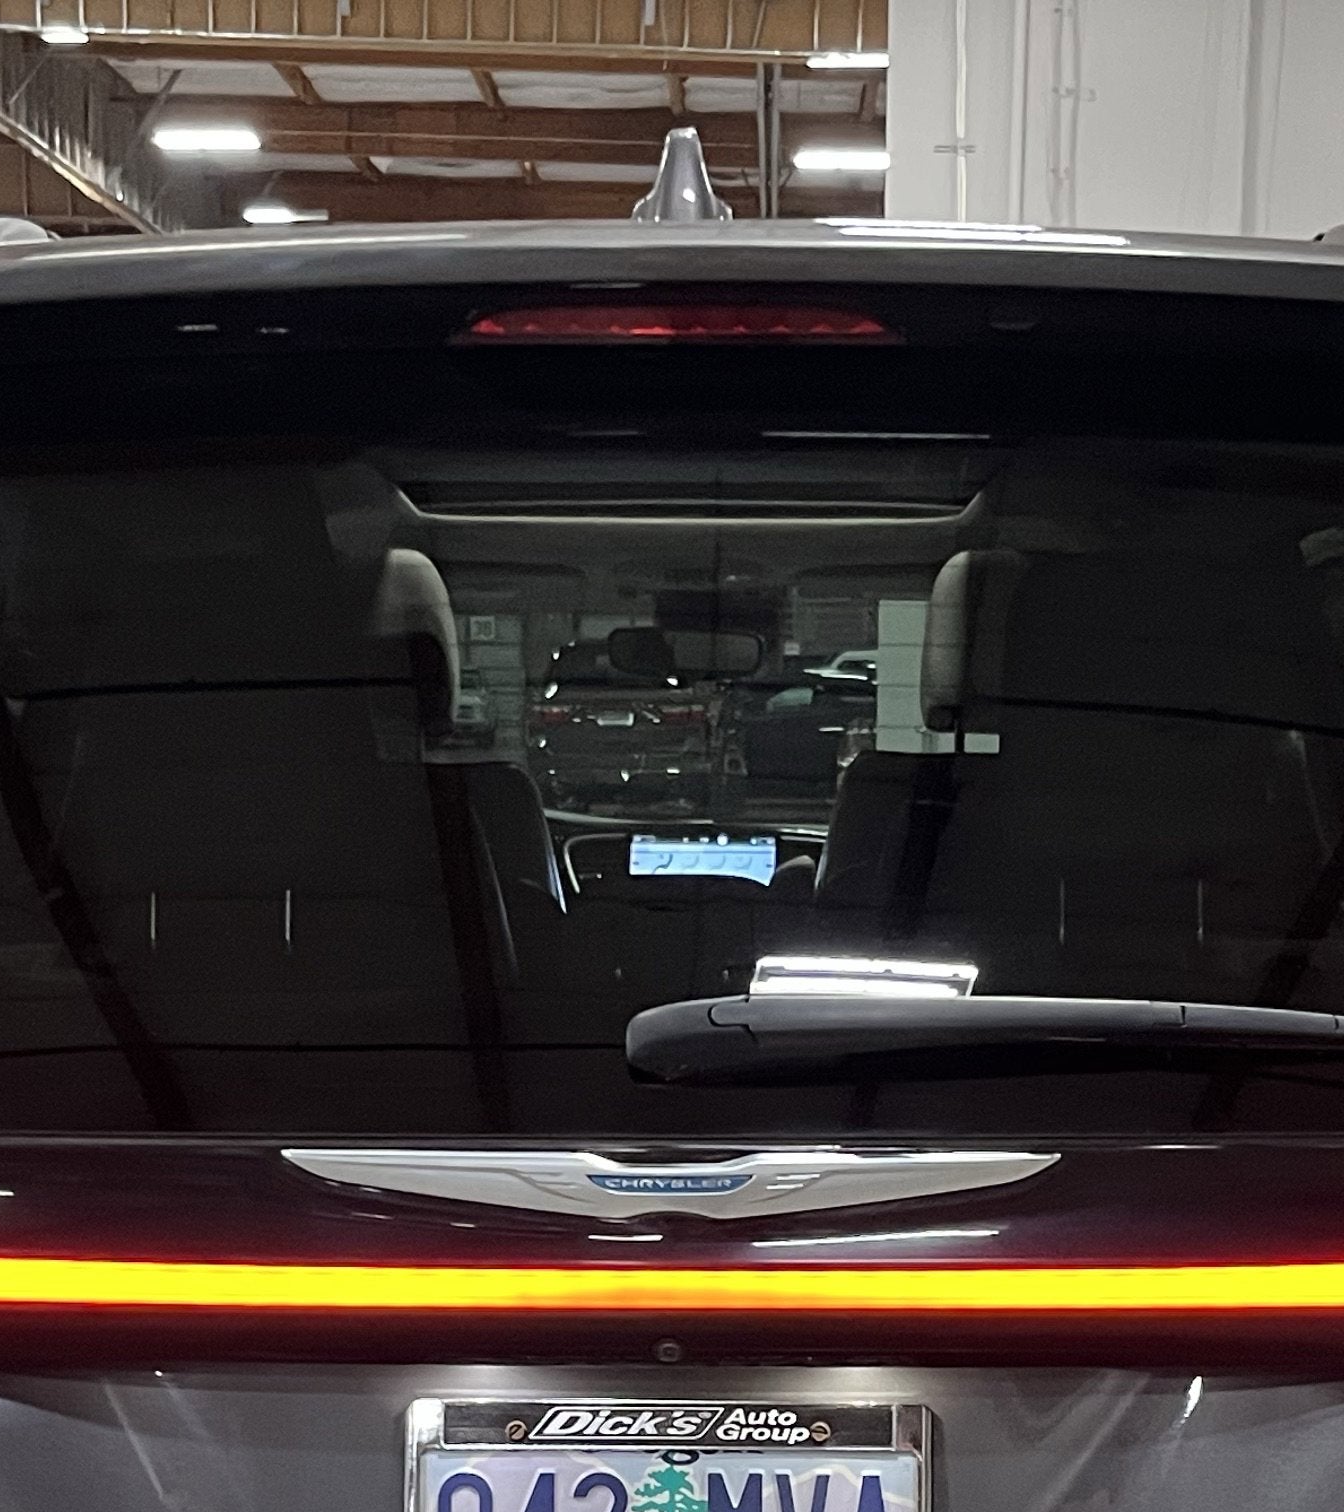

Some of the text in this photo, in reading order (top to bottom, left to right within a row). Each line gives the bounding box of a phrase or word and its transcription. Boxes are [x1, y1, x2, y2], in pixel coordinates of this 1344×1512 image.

[605, 1178, 732, 1189] CHRYSLER
[542, 1410, 702, 1437] Dick's
[723, 1408, 798, 1426] Auto
[716, 1423, 810, 1444] Group
